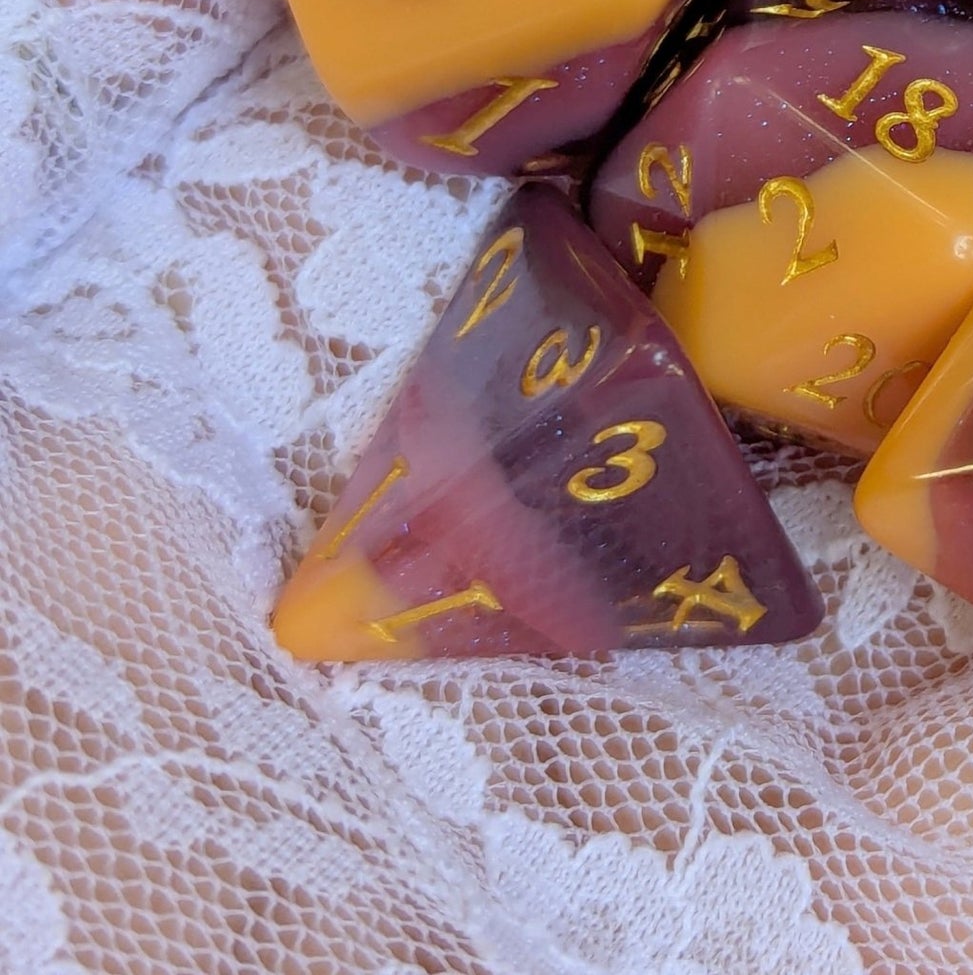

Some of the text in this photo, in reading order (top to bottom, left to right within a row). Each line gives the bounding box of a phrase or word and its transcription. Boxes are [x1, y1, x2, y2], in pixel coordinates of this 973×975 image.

[817, 45, 959, 163] 18
[631, 142, 694, 280] 12
[758, 176, 839, 286] 2
[456, 226, 524, 340] 2
[519, 326, 600, 400] 3
[567, 420, 667, 503] 3
[366, 580, 504, 643] 1
[652, 555, 768, 633] 4
